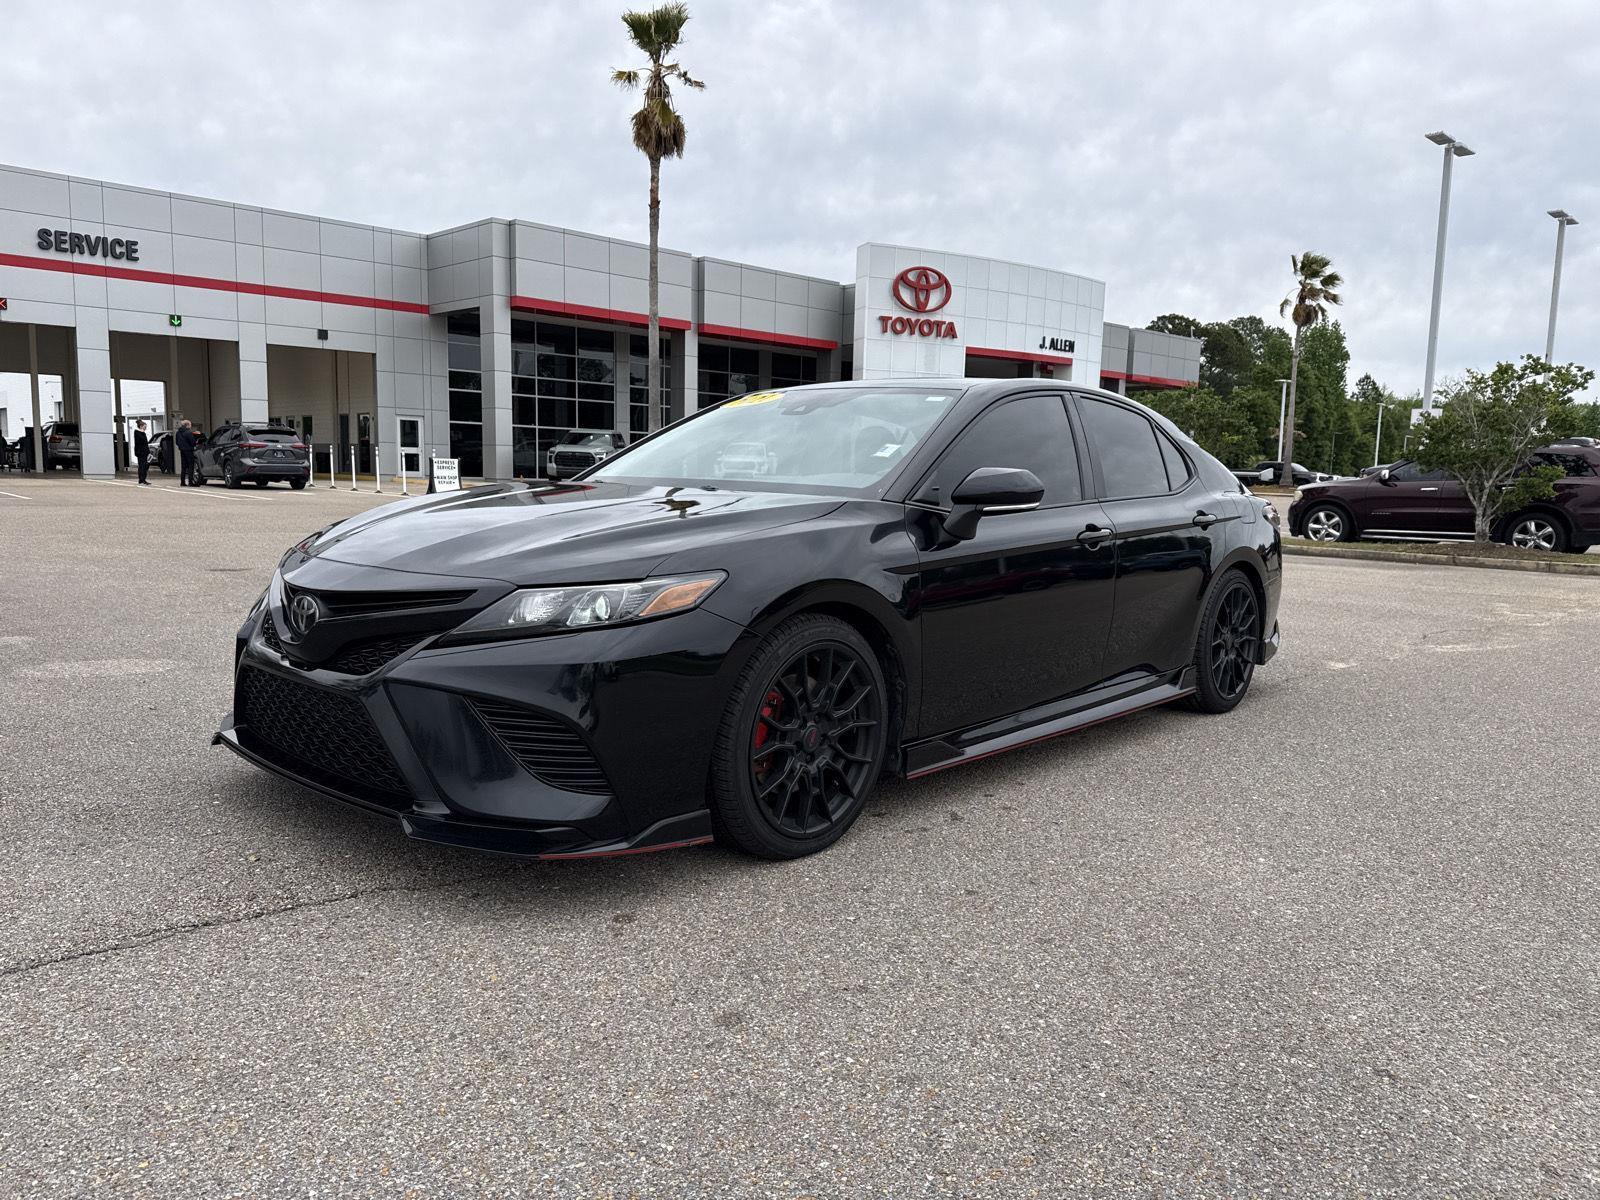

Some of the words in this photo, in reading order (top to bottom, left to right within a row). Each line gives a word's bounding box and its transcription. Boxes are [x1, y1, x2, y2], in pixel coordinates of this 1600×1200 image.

[37, 228, 139, 261] SERVICE
[879, 316, 958, 338] TOYOTA
[1039, 336, 1048, 350] J.
[1049, 337, 1075, 353] ALLEN
